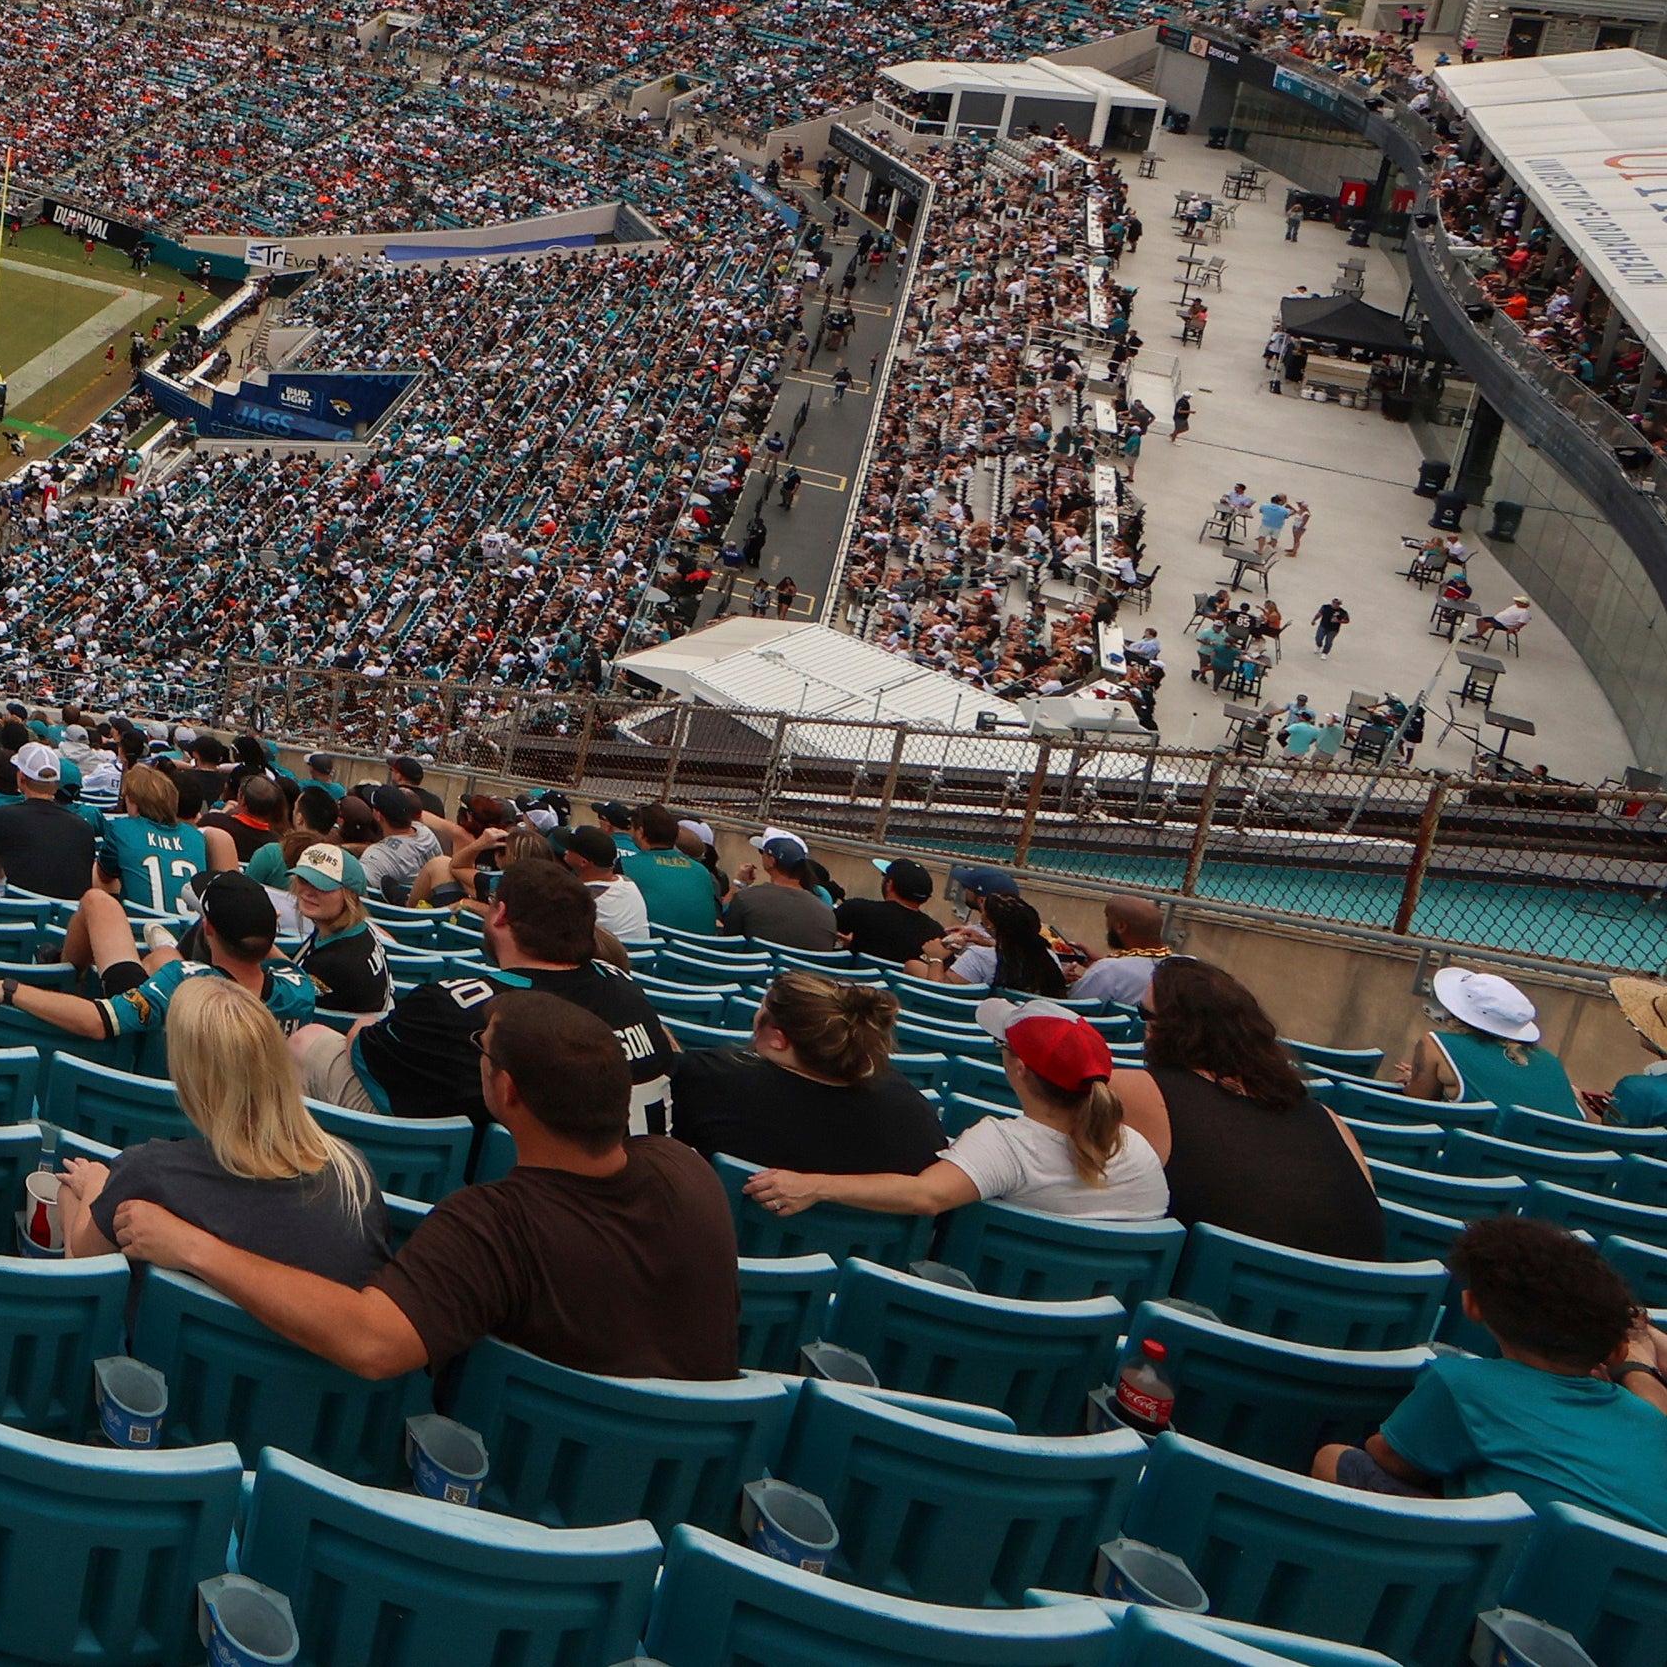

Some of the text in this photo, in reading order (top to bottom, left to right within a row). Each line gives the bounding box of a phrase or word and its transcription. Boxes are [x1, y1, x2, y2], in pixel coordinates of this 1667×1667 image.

[1524, 159, 1594, 199] UNIVERSITY
[1601, 248, 1667, 285] HEALTH
[281, 393, 314, 407] LIGHT
[285, 387, 310, 398] BUD
[233, 405, 293, 435] JAGS
[1236, 617, 1250, 628] 85
[147, 833, 183, 851] KIRK
[143, 856, 198, 912] 13
